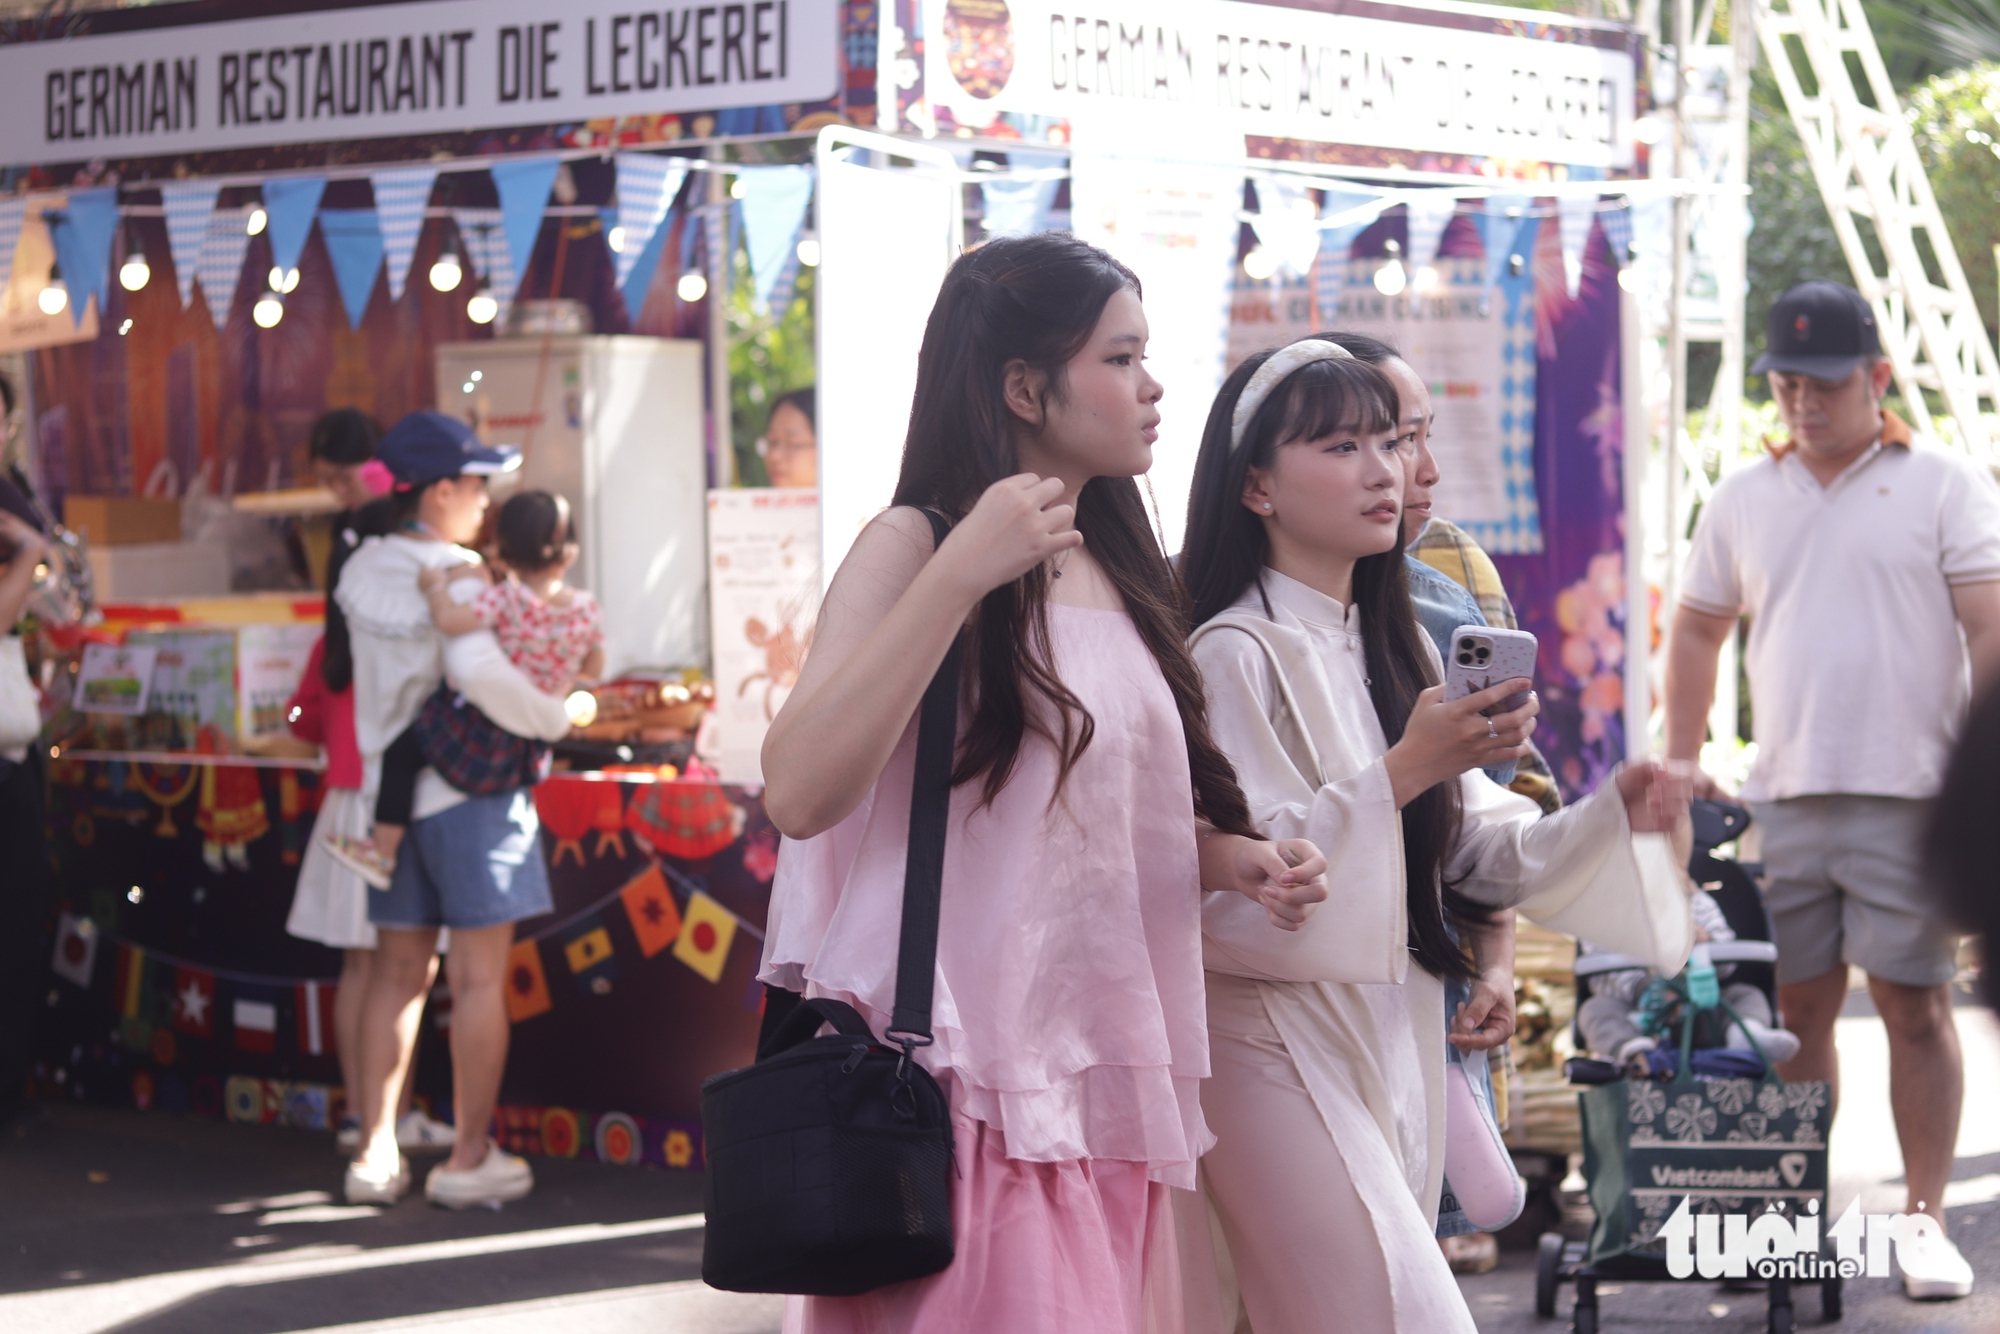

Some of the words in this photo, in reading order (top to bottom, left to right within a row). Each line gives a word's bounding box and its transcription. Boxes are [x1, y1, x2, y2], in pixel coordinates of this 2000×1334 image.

[45, 54, 198, 143] GERMAN
[218, 31, 474, 128] RESTAURANT
[498, 21, 561, 104] DIE
[585, 0, 788, 96] LECKEREI
[1051, 14, 1192, 101] GERMAN
[1435, 60, 1474, 130] DE
[1651, 1163, 1781, 1189] Vietcombank
